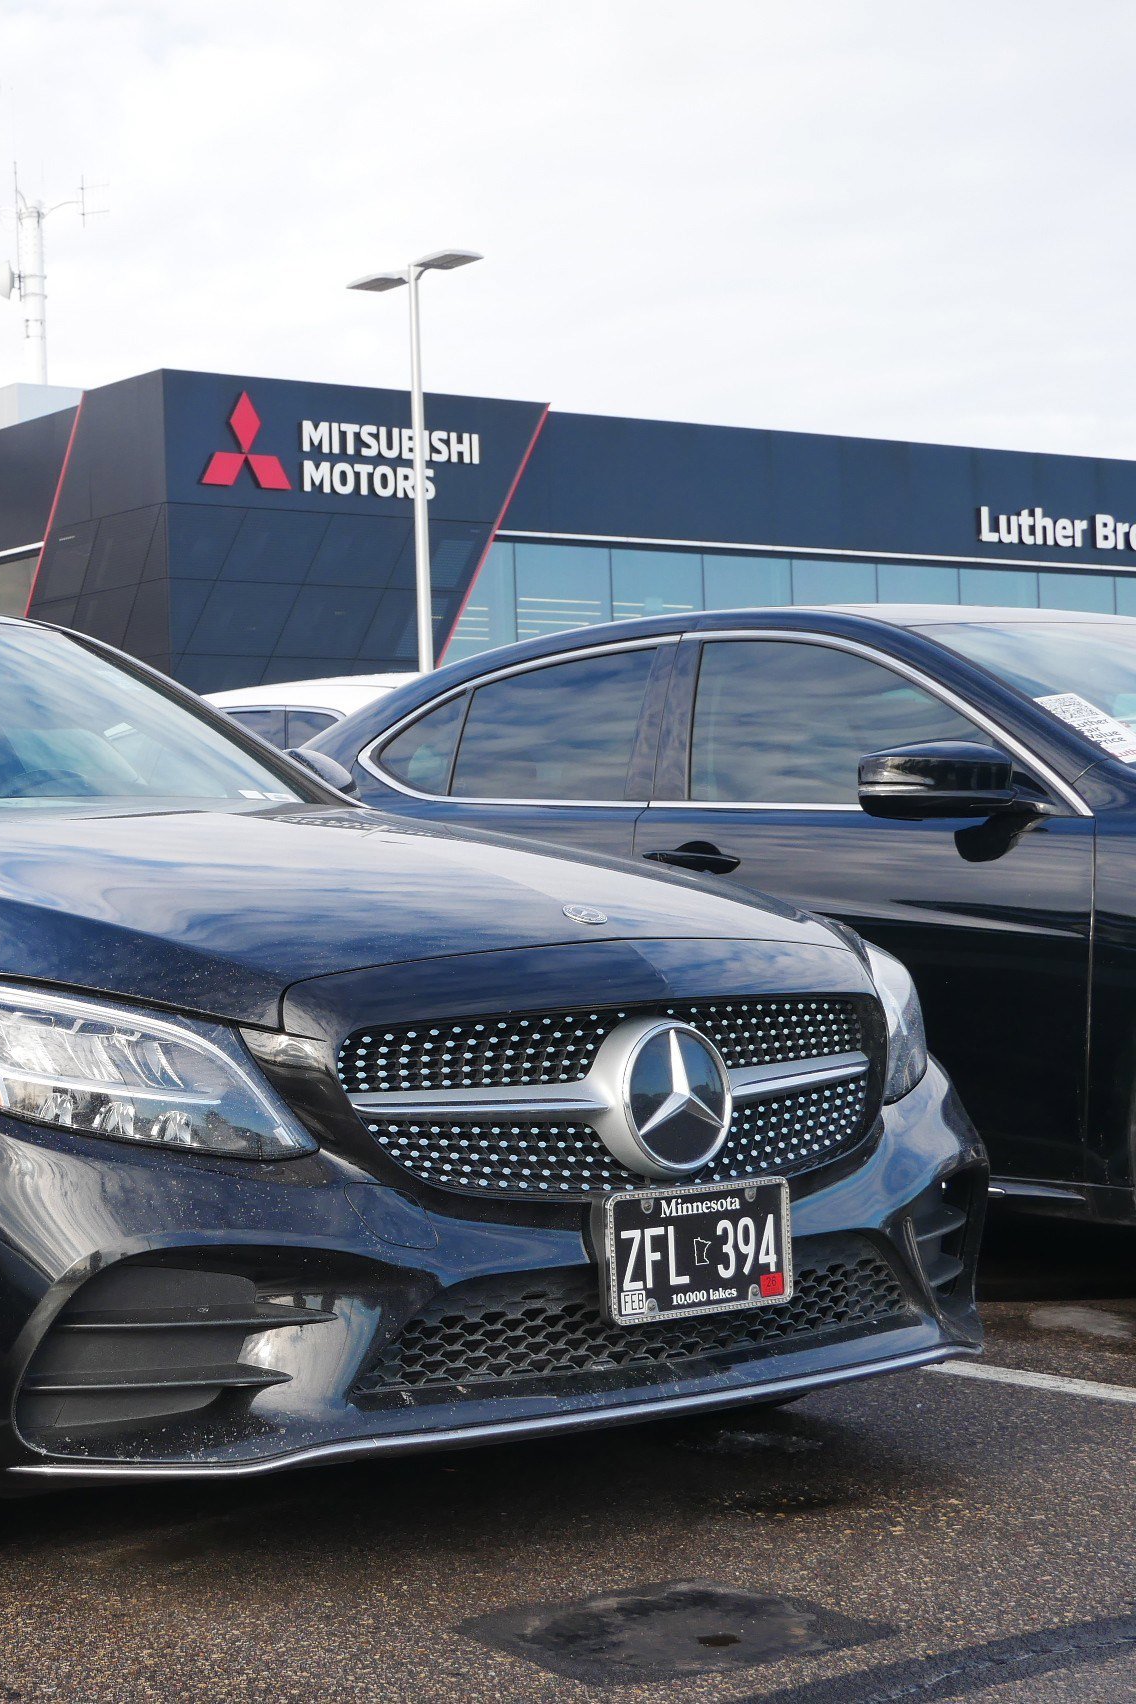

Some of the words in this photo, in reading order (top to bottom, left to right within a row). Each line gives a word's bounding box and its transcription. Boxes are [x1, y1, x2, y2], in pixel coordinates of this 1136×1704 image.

[302, 460, 436, 500] MOTORS
[979, 505, 1088, 548] Luther
[660, 1195, 741, 1218] Minnesota
[620, 1225, 690, 1291] ZFL
[716, 1213, 778, 1279] 394
[766, 1276, 777, 1287] 26
[624, 1293, 645, 1312] FEB
[671, 1290, 707, 1305] 10,000
[709, 1287, 738, 1300] lakes
